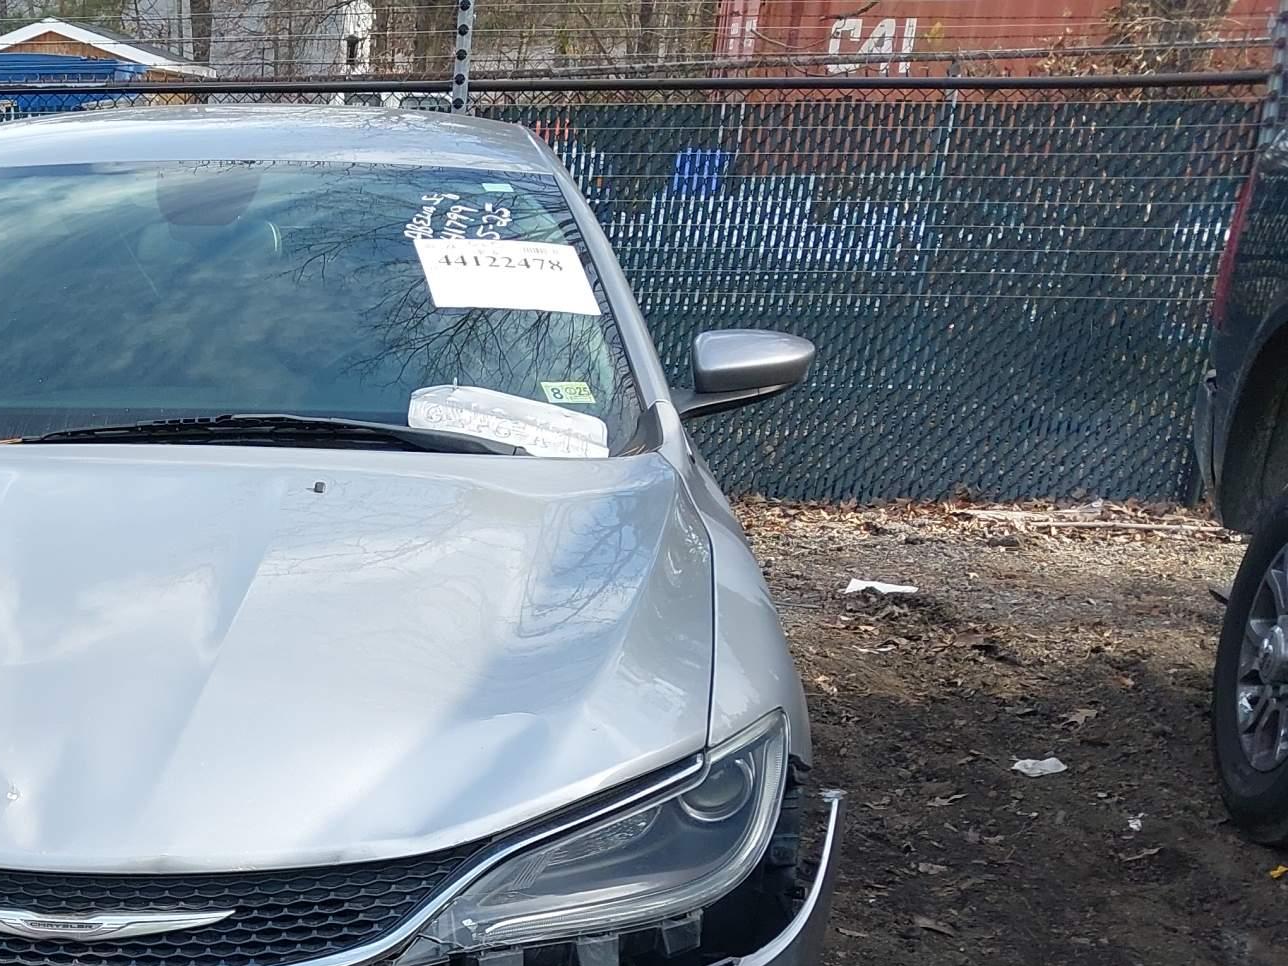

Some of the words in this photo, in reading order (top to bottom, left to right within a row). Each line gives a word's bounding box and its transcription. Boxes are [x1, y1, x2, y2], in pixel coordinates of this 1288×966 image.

[826, 17, 917, 73] CAI
[438, 254, 563, 272] 44122478
[550, 387, 564, 400] 8
[30, 921, 93, 929] CHRYSLER
